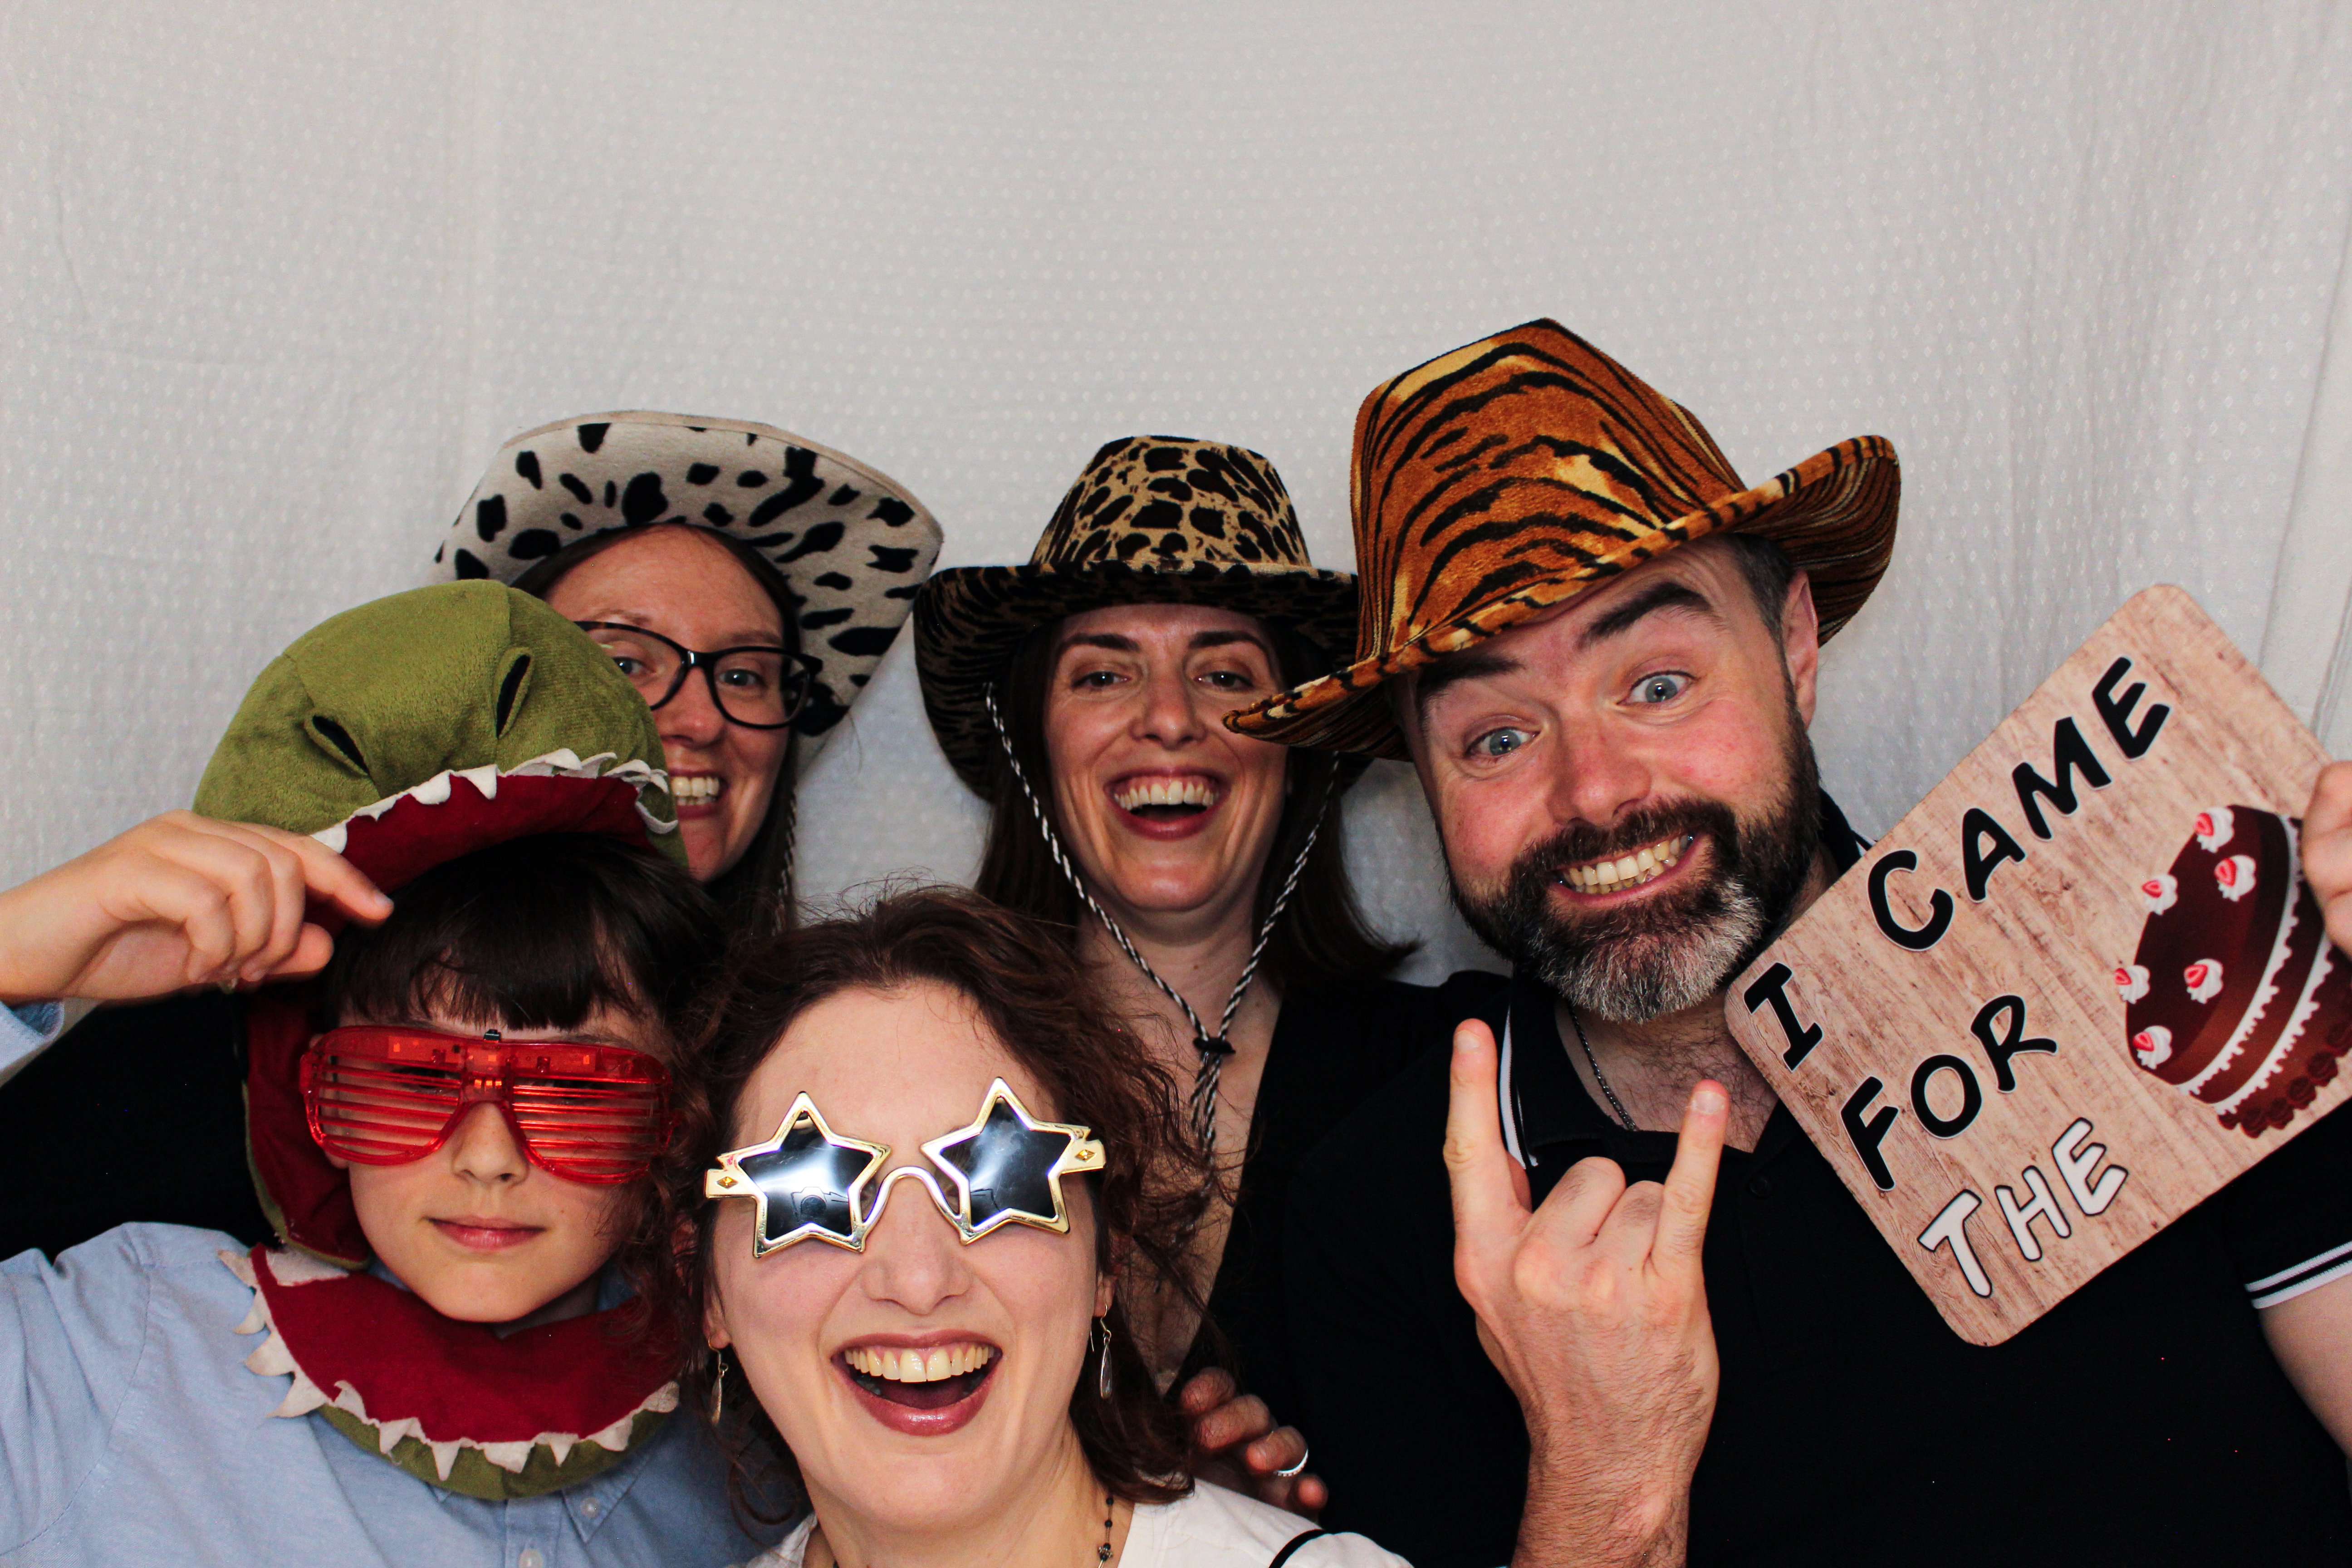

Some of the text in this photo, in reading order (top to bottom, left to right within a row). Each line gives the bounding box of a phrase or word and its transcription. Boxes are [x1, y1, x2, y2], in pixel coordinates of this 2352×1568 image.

[1744, 657, 2170, 1071] I CAME
[1840, 995, 2057, 1191] FOR
[1918, 1117, 2128, 1298] THE
